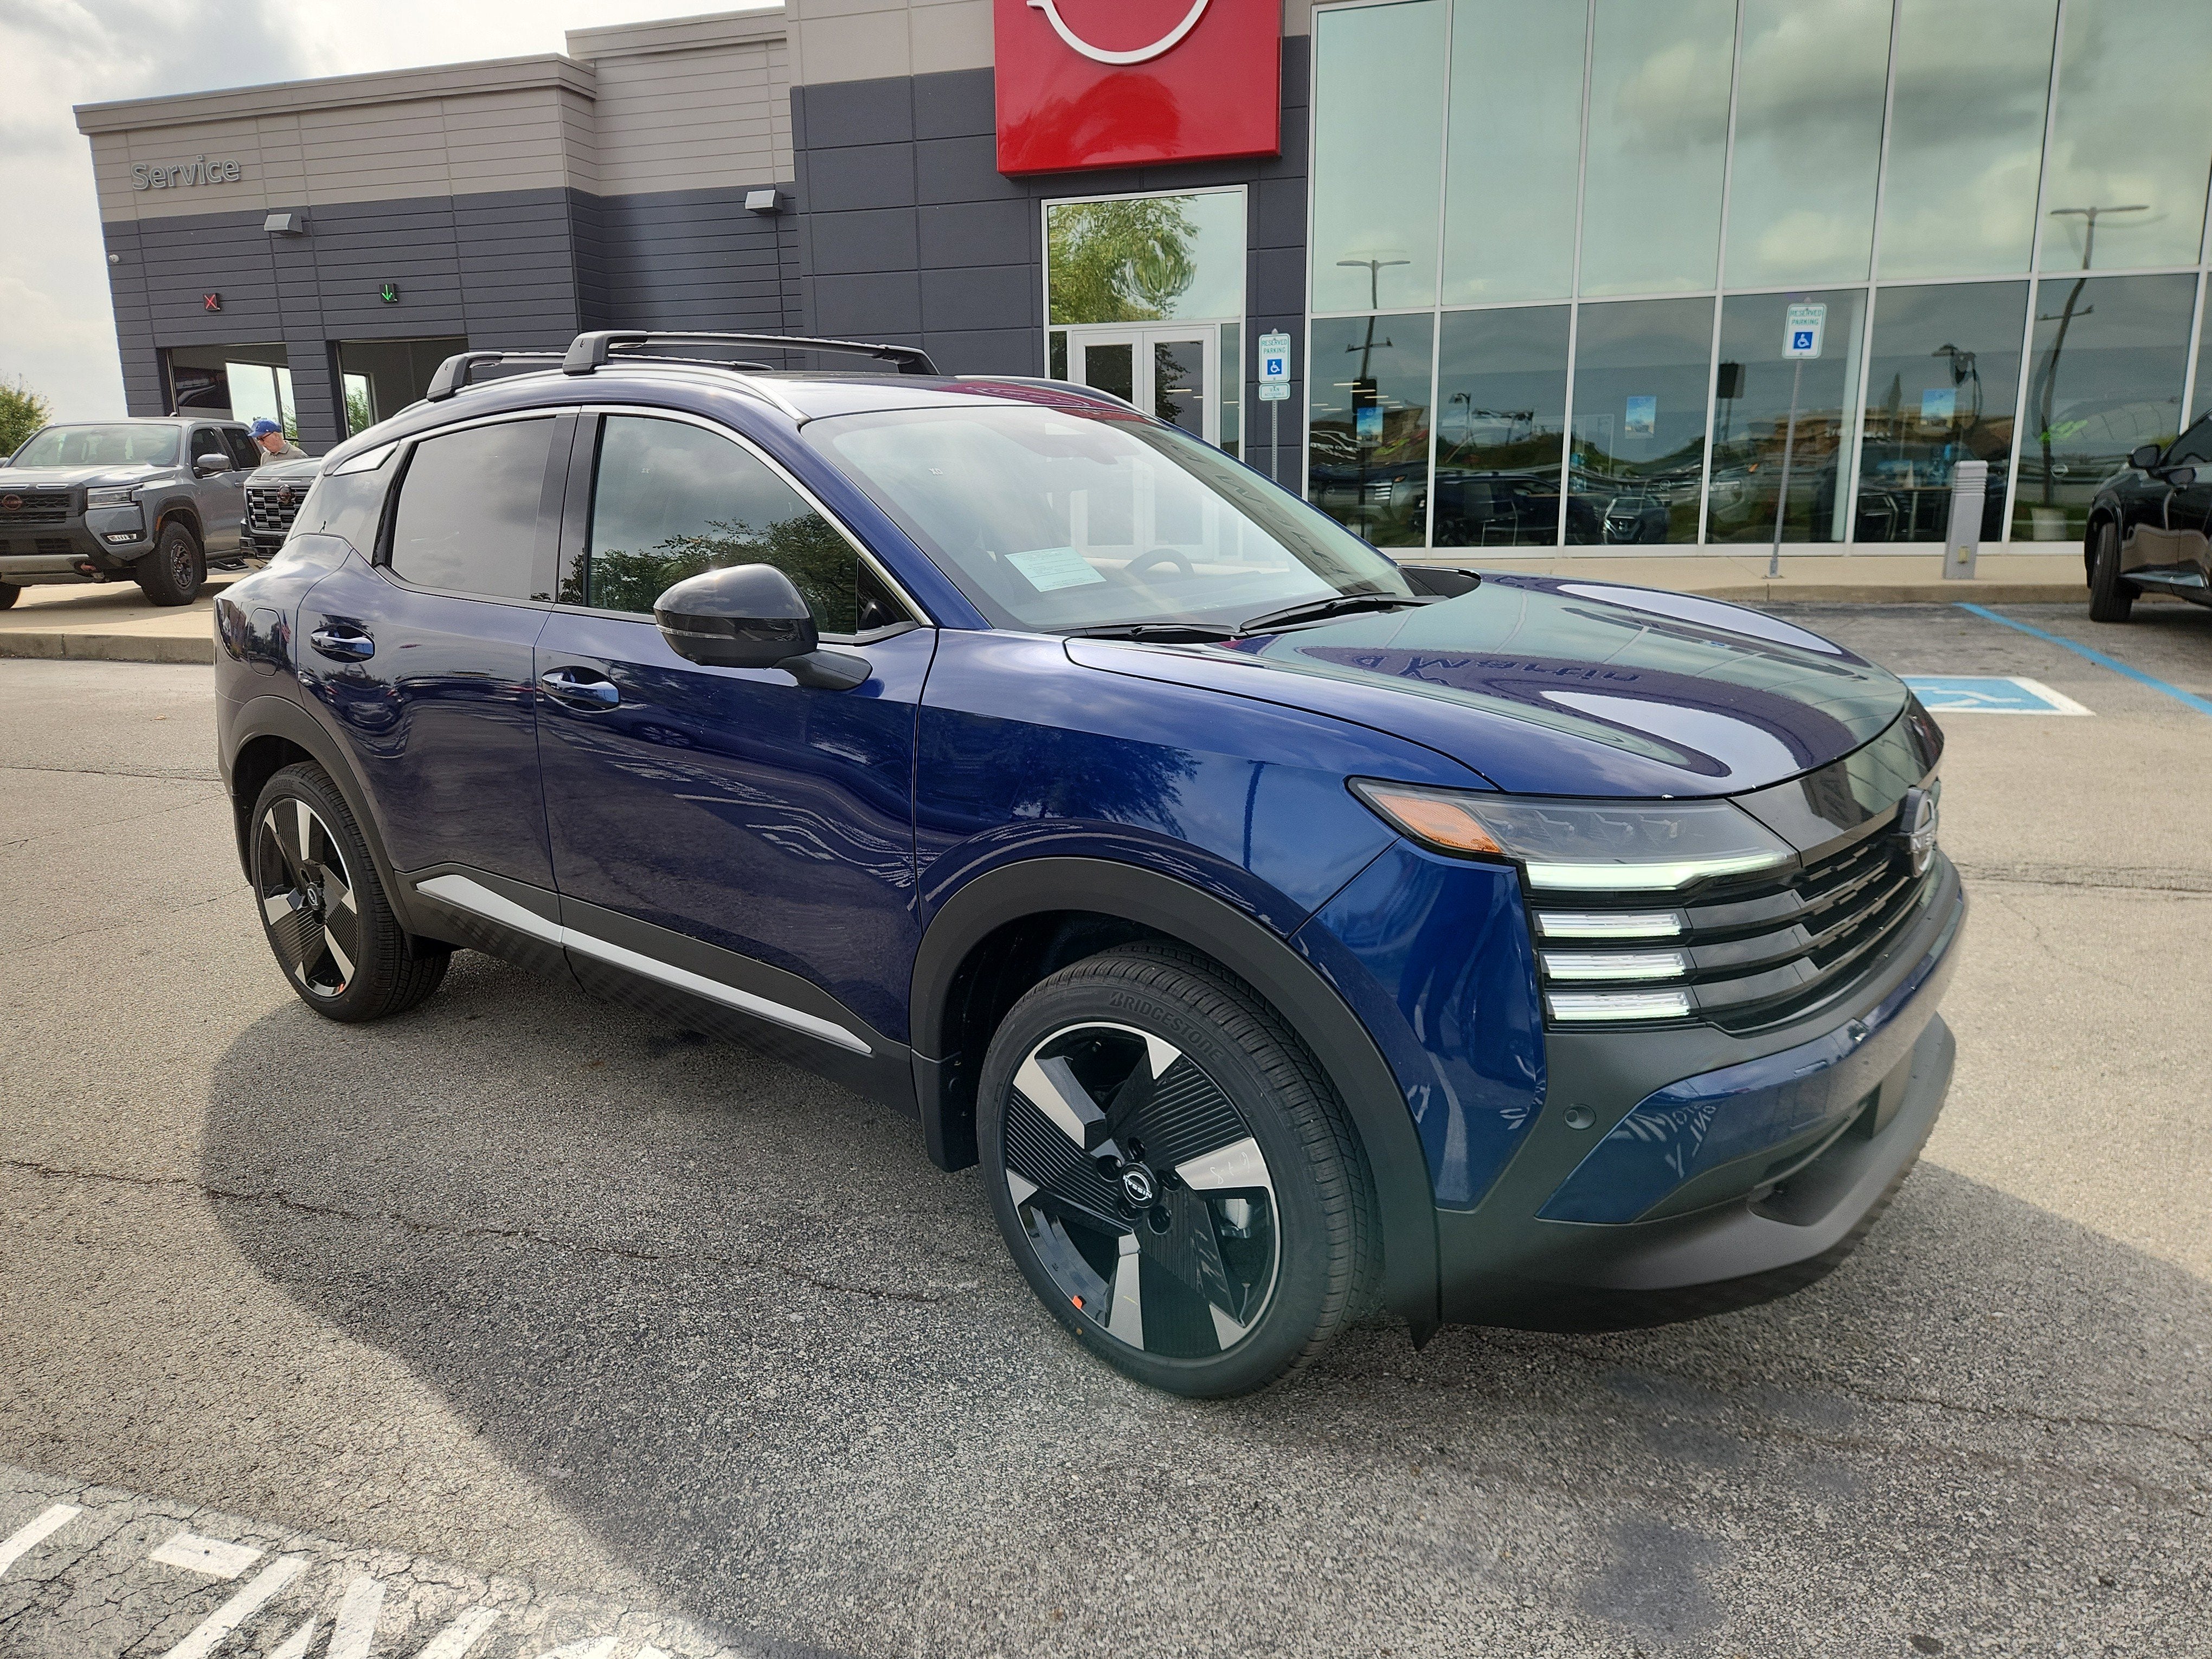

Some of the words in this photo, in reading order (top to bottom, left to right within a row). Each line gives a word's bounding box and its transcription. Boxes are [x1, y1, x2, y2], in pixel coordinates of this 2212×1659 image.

[131, 154, 242, 190] Service
[1109, 991, 1224, 1061] BRIDGESTONE
[1123, 1174, 1153, 1198] NISSAN
